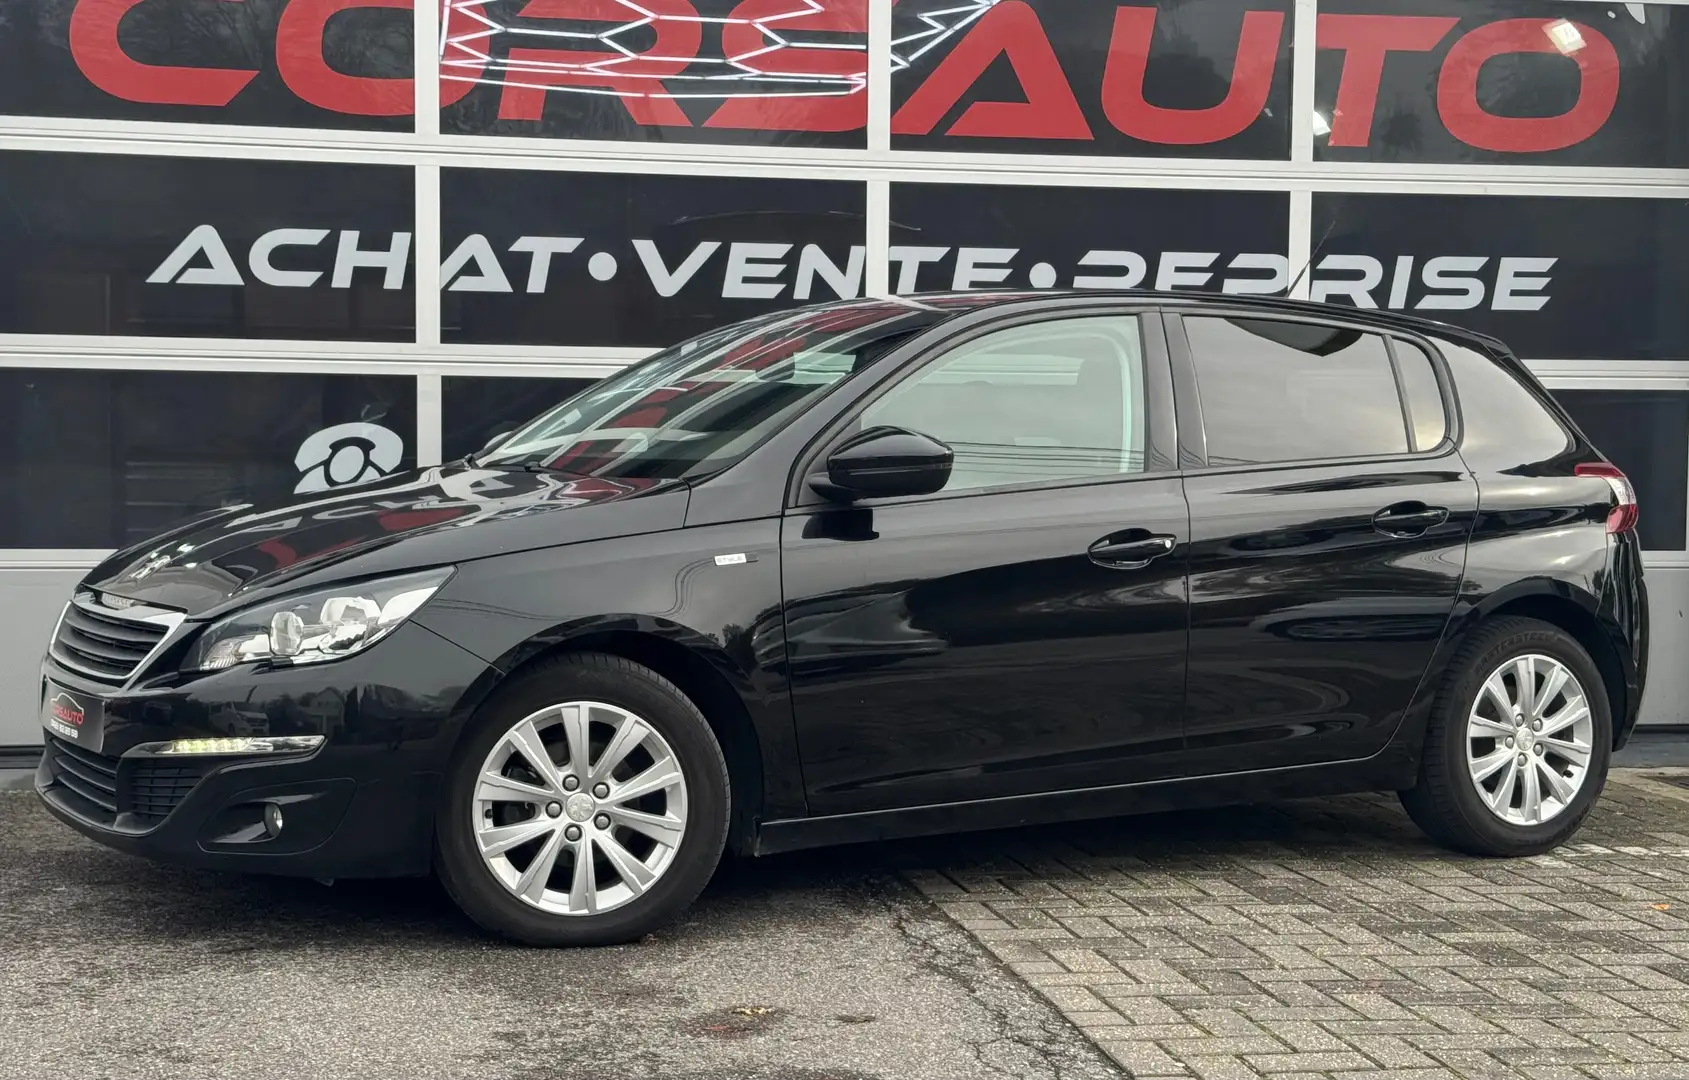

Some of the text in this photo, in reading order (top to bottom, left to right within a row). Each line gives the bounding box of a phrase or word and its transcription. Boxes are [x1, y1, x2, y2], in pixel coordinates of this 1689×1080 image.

[68, 0, 1621, 153] CORSAUTO
[146, 224, 585, 294] ACHAT
[632, 239, 1020, 300] VENTE
[51, 701, 84, 725] SAUTO
